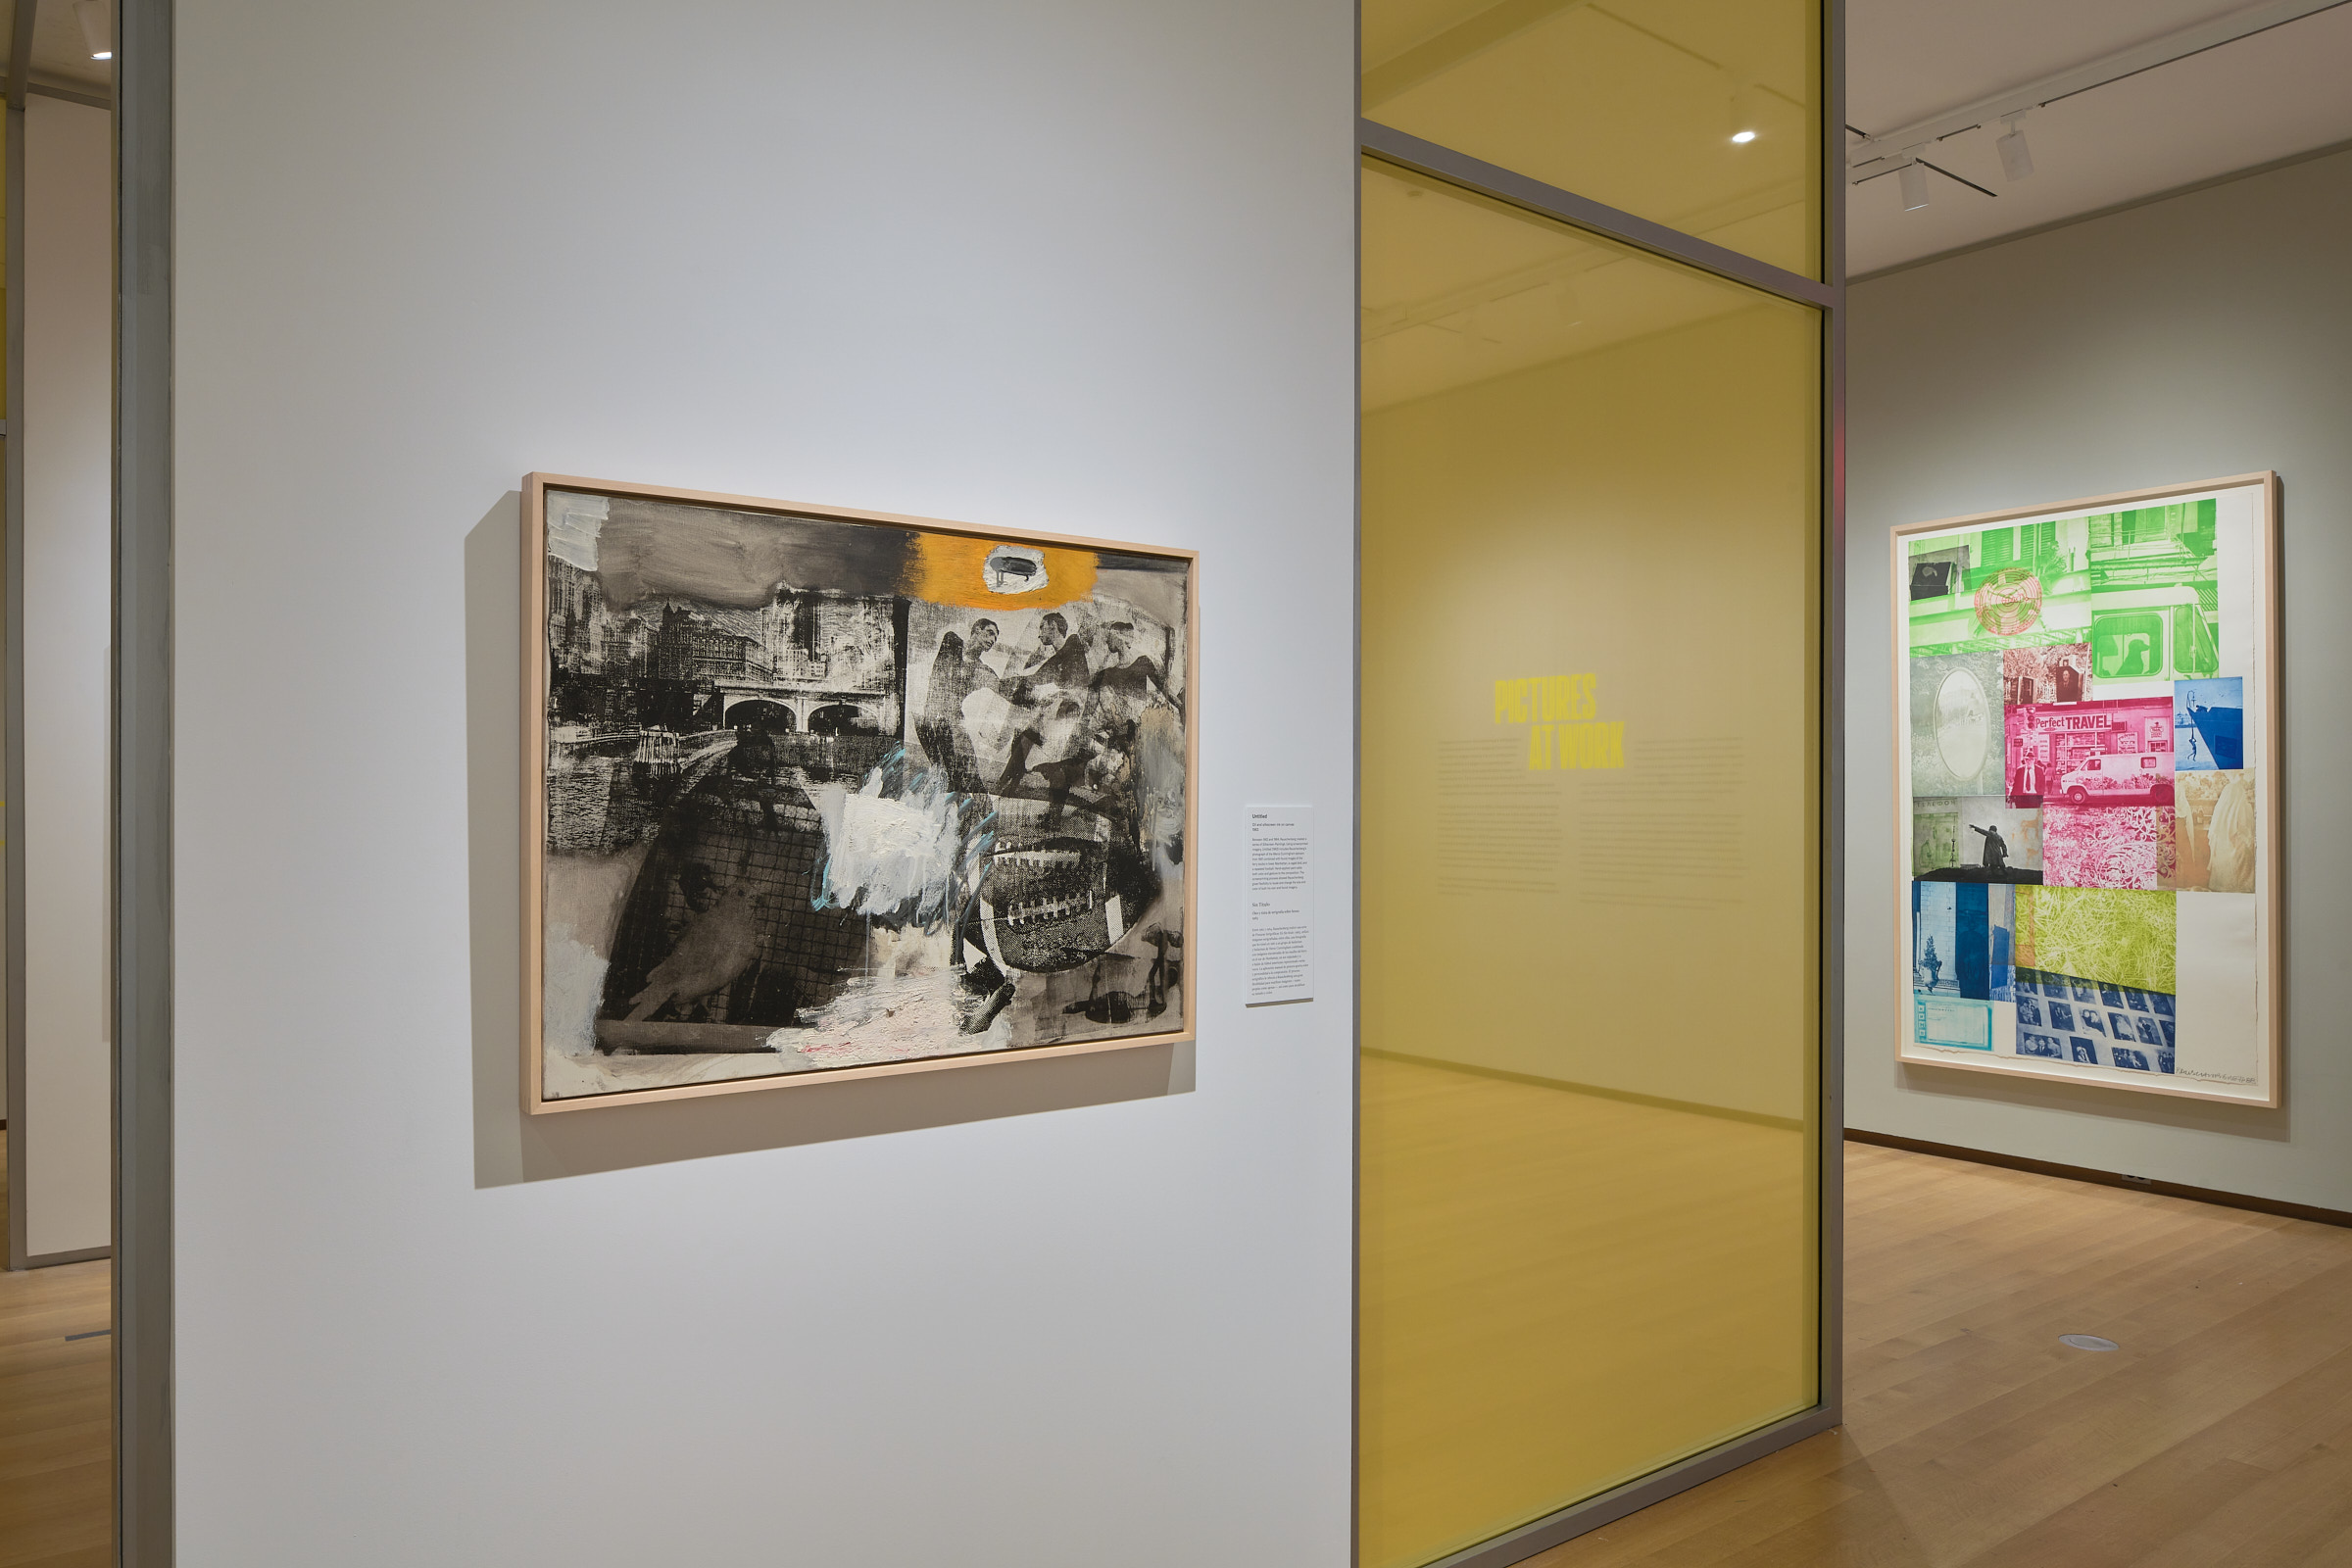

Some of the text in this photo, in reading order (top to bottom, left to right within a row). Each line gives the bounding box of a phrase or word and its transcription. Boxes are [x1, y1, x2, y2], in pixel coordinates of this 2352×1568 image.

[1495, 672, 1596, 723] PICTURES
[2035, 714, 2111, 730] Perfect TRAVEL
[1529, 724, 1554, 770] AT
[1558, 720, 1625, 769] WORK
